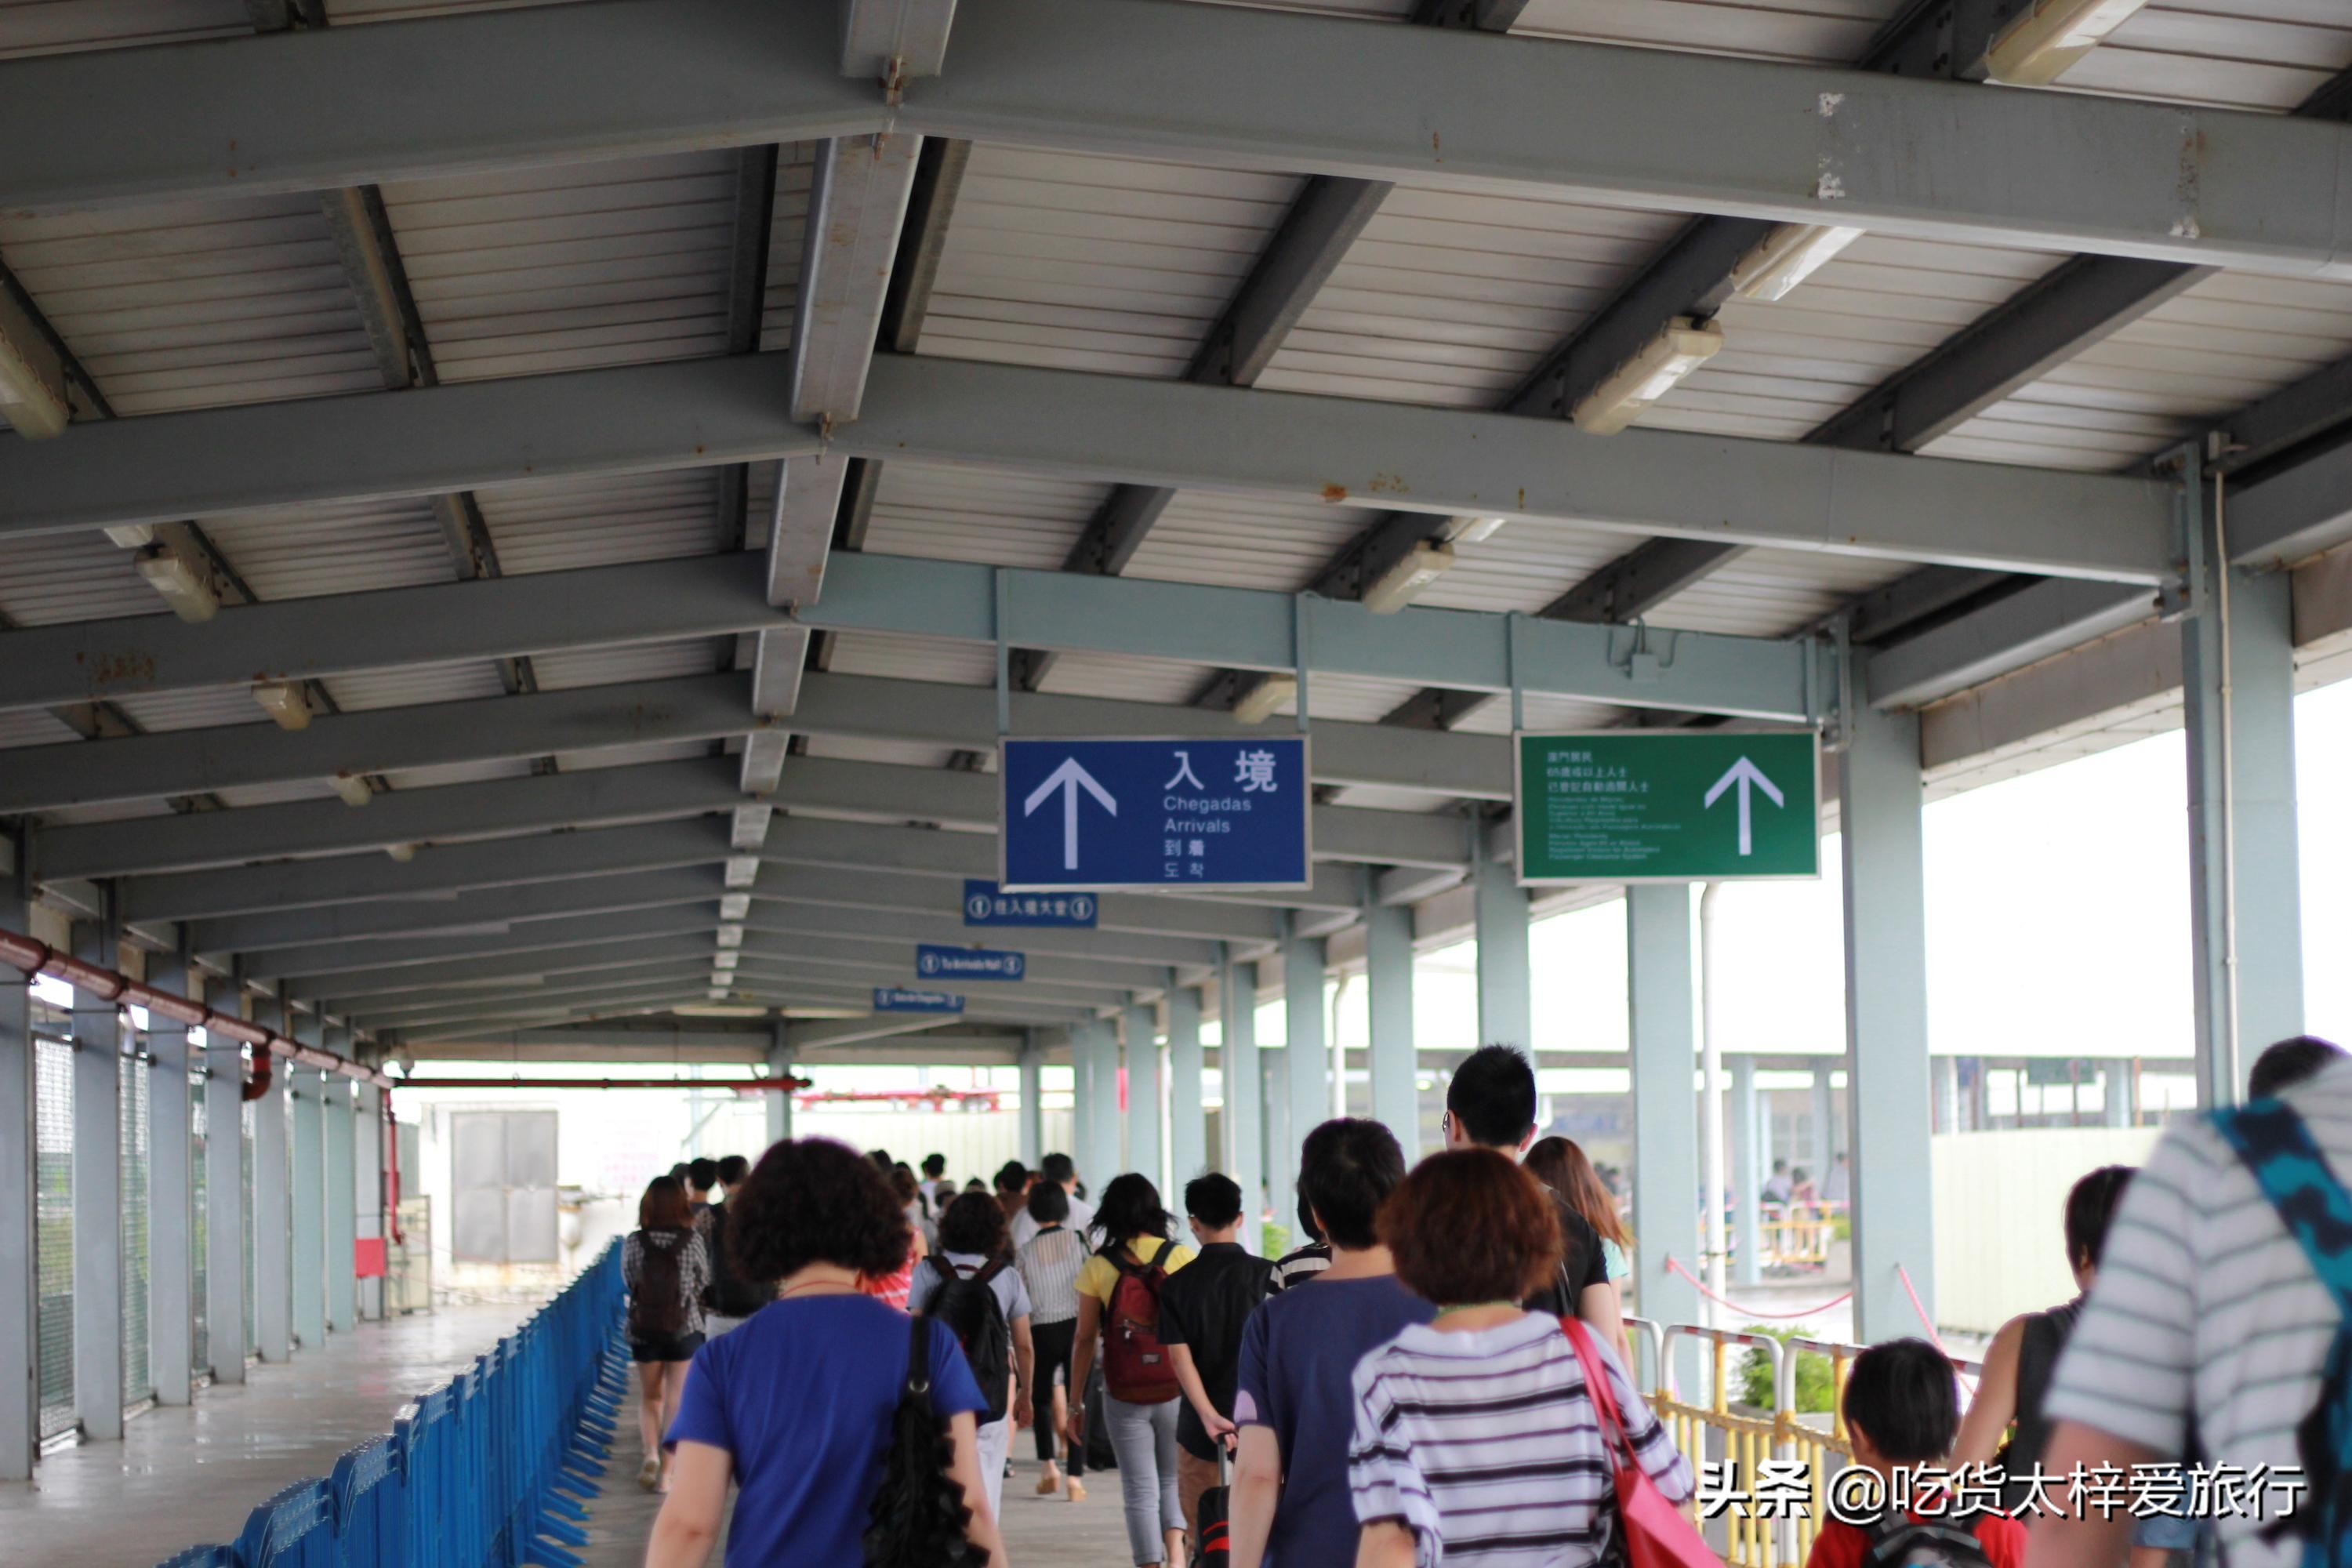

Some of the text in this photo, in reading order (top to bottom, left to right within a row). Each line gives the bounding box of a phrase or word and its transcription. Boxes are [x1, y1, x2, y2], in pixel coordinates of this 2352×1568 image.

[1164, 750, 1278, 792] 入境
[1163, 796, 1252, 815] Chegadas
[1164, 818, 1231, 833] Arrivals
